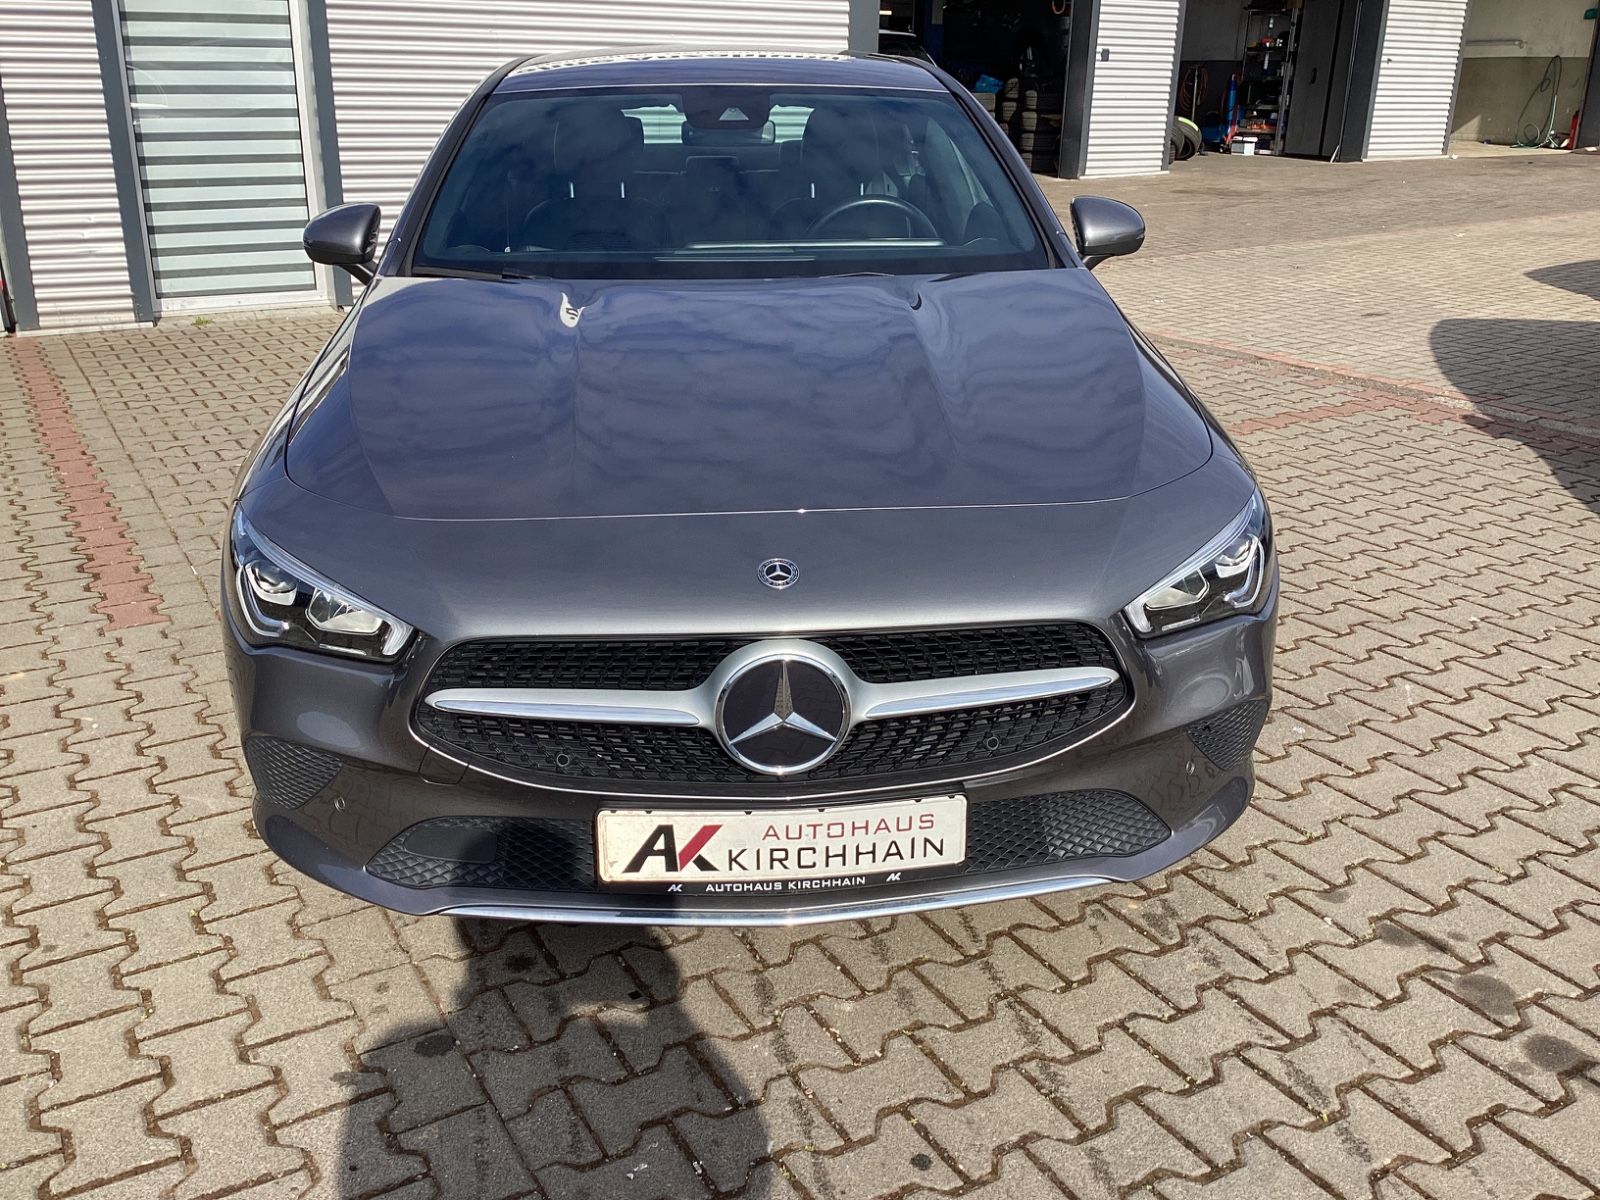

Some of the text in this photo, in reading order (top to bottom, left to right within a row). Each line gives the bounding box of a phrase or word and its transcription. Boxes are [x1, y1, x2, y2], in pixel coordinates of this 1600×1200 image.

[762, 813, 935, 841] AUTOHAUS
[622, 824, 723, 873] AK
[728, 837, 944, 872] KIRCHHAIN
[705, 881, 782, 892] AUTOHAUS
[788, 876, 866, 890] KIRCHHAIN
